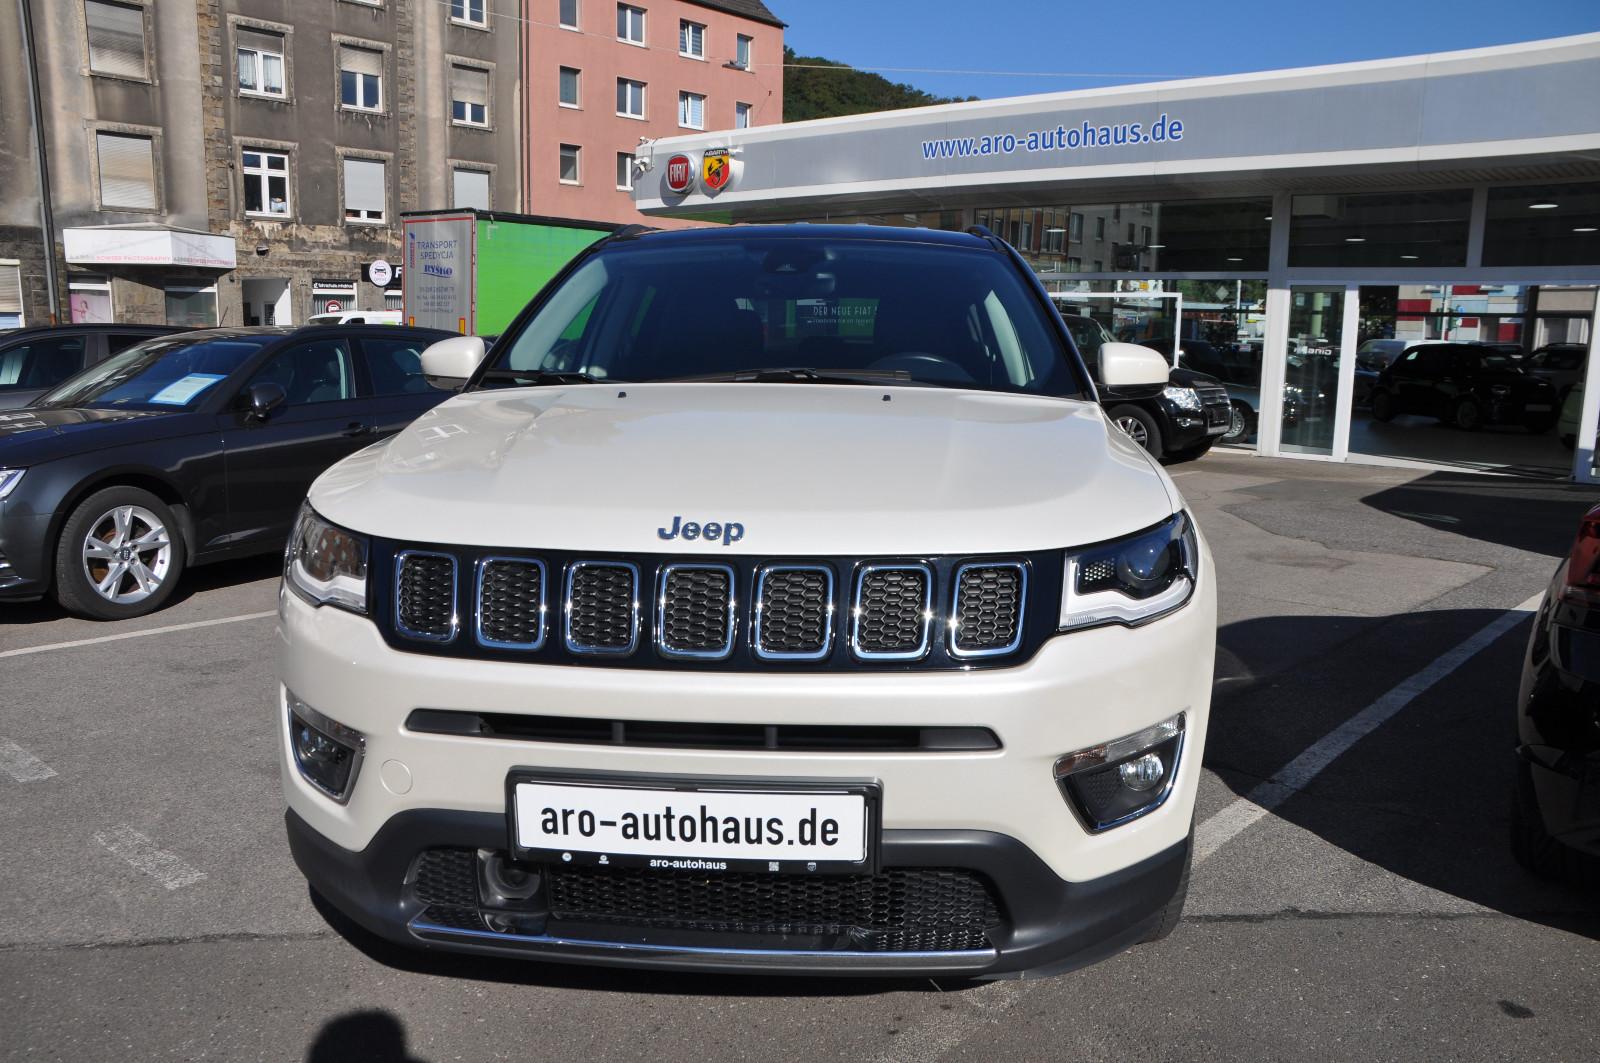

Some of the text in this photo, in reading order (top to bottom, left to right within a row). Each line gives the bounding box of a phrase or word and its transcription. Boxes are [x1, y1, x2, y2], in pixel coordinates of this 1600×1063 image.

[922, 113, 1184, 161] www.aro-autohaus.de
[669, 163, 687, 182] FIAT
[416, 240, 457, 249] TRANSPORT
[831, 306, 851, 316] NEUE
[854, 306, 872, 316] FIAT
[657, 516, 744, 546] Jeep
[541, 804, 839, 846] aro-autohaus.de
[649, 858, 727, 870] aro-autohaus
